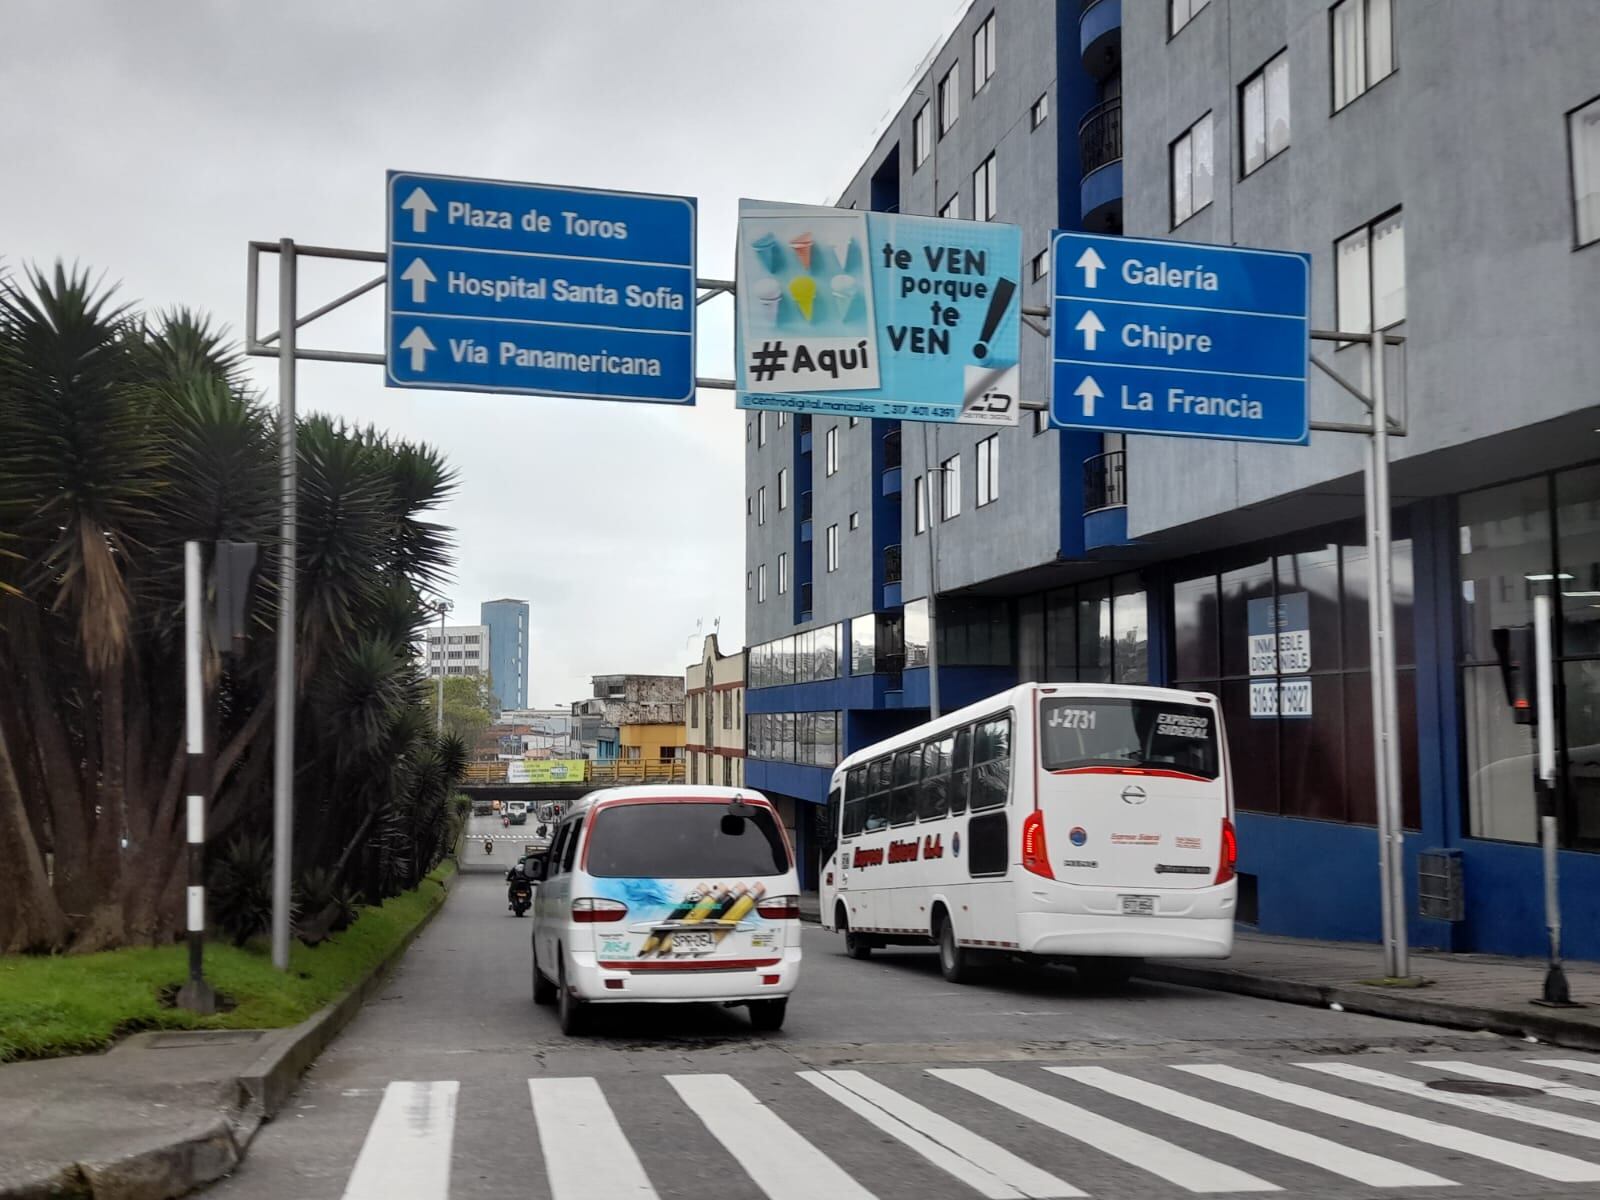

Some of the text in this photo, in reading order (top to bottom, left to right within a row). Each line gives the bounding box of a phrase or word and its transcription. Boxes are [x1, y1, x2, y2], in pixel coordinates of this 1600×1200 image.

[448, 201, 628, 240] Plaza de Toros
[882, 243, 986, 276] te VEN
[1121, 259, 1219, 291] Galería
[448, 271, 684, 311] Hospital Santa Sofía
[902, 276, 988, 301] porque
[930, 301, 960, 326] te
[886, 325, 950, 355] VEN
[1121, 323, 1212, 355] Chipre
[449, 338, 661, 376] Vía Panamericana
[749, 340, 869, 381] #Aquí
[1120, 384, 1263, 419] La Francia
[1048, 708, 1097, 730] J-2731
[1156, 713, 1208, 728] EXPRESO
[1156, 724, 1209, 739] SIDERAL
